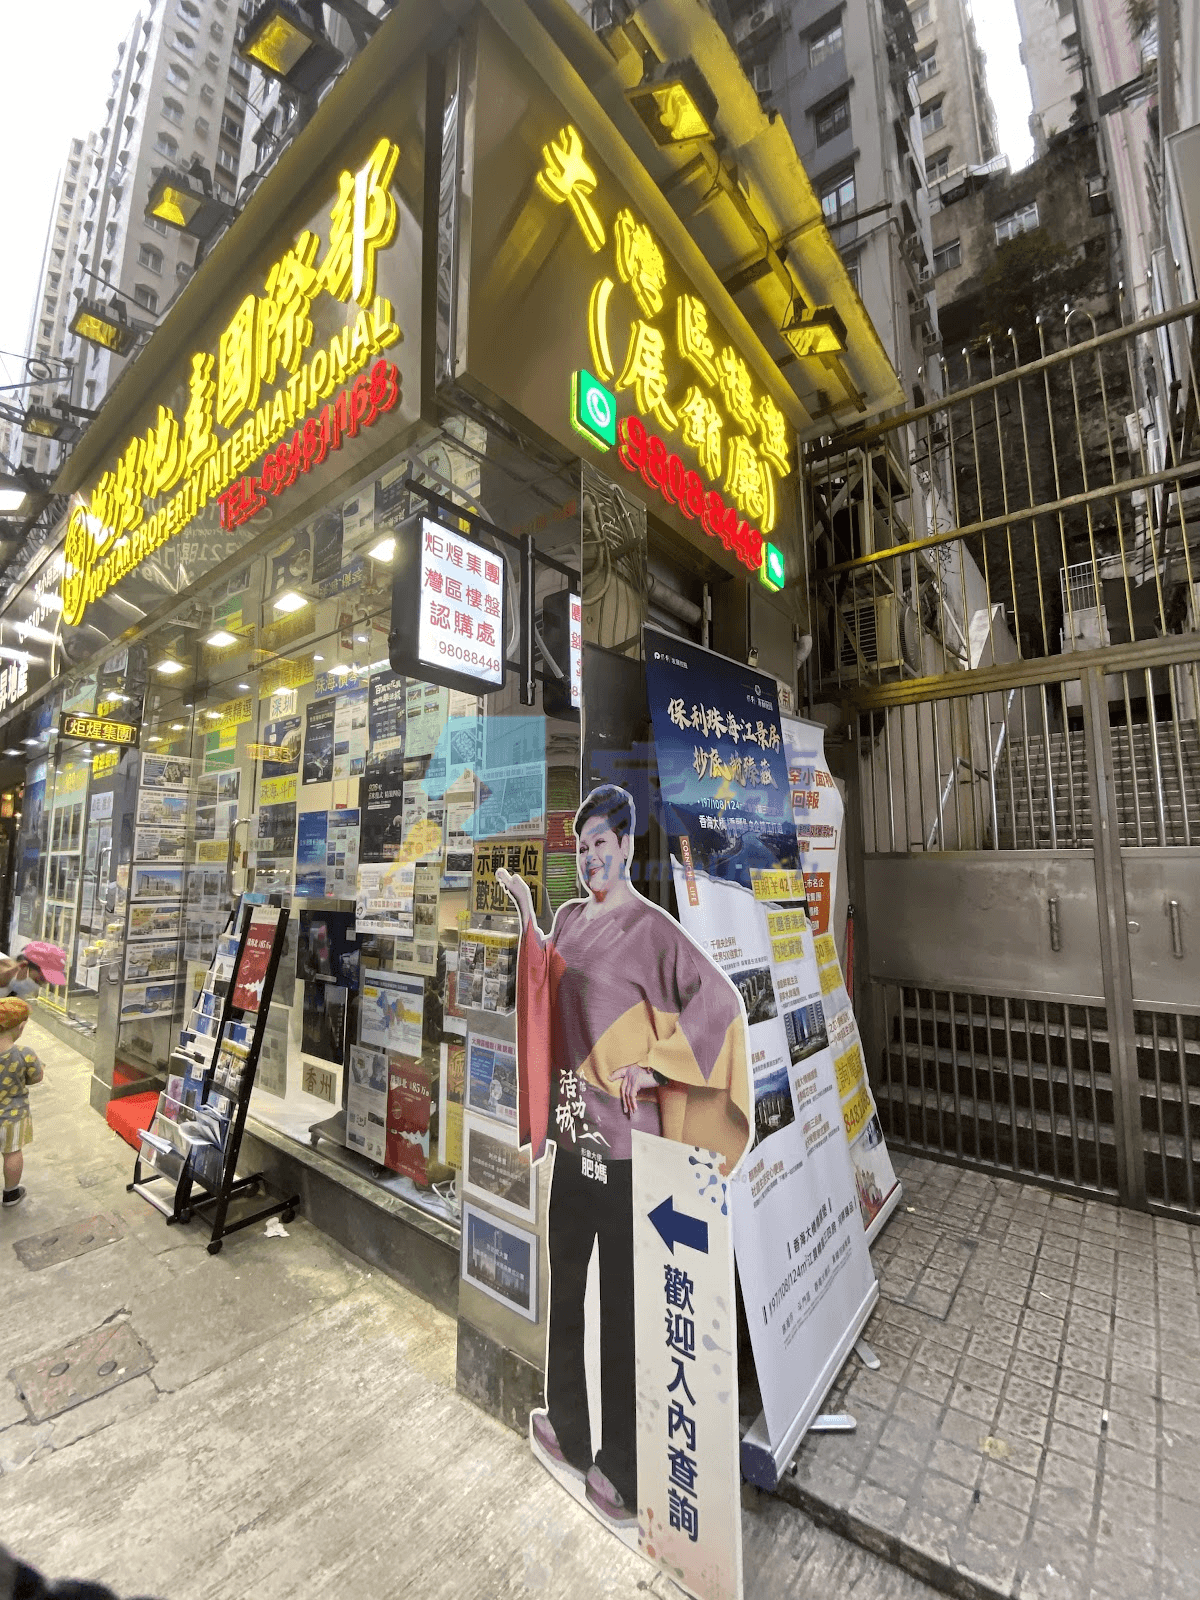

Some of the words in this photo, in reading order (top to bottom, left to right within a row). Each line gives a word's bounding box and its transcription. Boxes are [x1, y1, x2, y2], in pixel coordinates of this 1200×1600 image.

[132, 472, 201, 563] PROPERTY
[200, 296, 400, 509] INTERNATIONAL
[617, 415, 763, 570] 98088448
[424, 566, 501, 619] 灣區樓盤
[429, 600, 496, 648] 認購處
[438, 640, 501, 673] 98088448
[475, 844, 539, 877] 示範單位
[305, 1066, 333, 1101] 香州
[580, 1156, 608, 1185] 肥媽
[663, 1263, 699, 1543] 歡迎入內查詢
